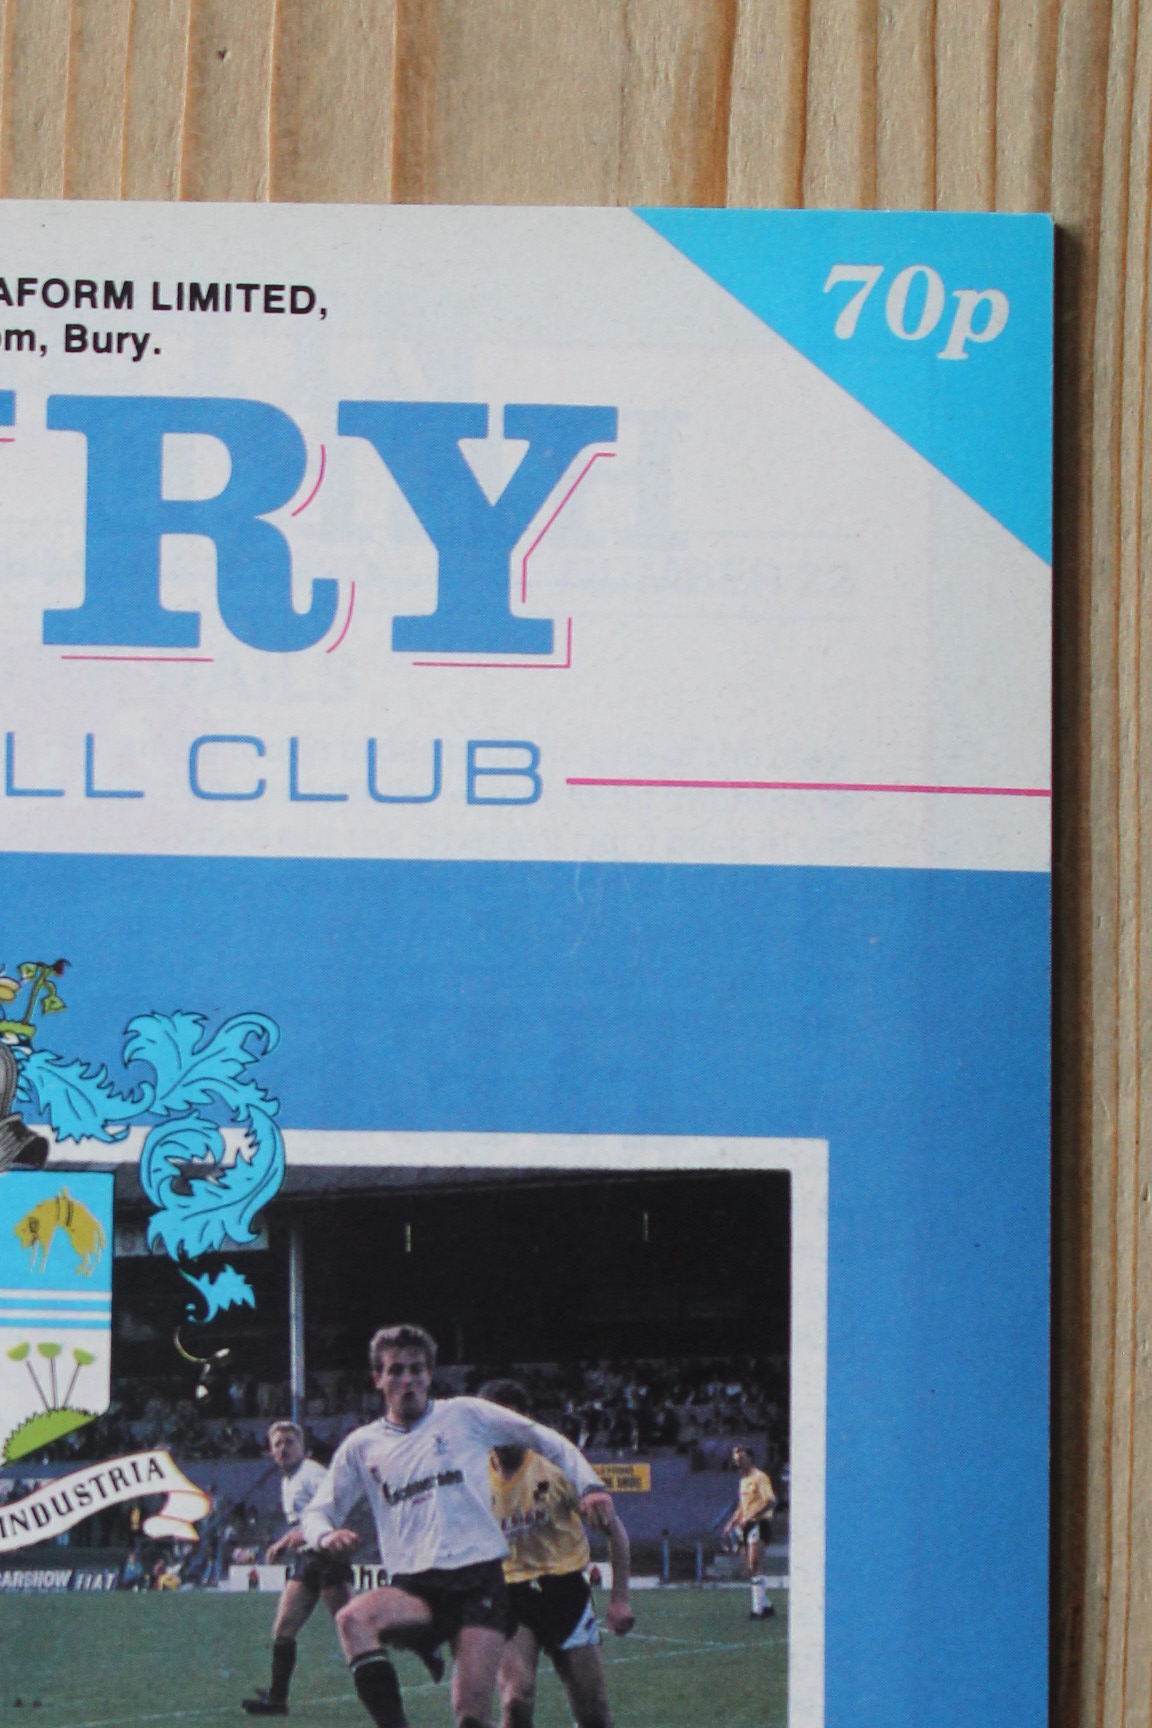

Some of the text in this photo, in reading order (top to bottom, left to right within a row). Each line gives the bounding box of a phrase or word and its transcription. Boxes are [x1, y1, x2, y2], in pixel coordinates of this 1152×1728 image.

[152, 281, 327, 321] LIMITED,
[821, 263, 1011, 361] 70p
[64, 323, 161, 363] Bury.
[188, 734, 543, 806] CLUB
